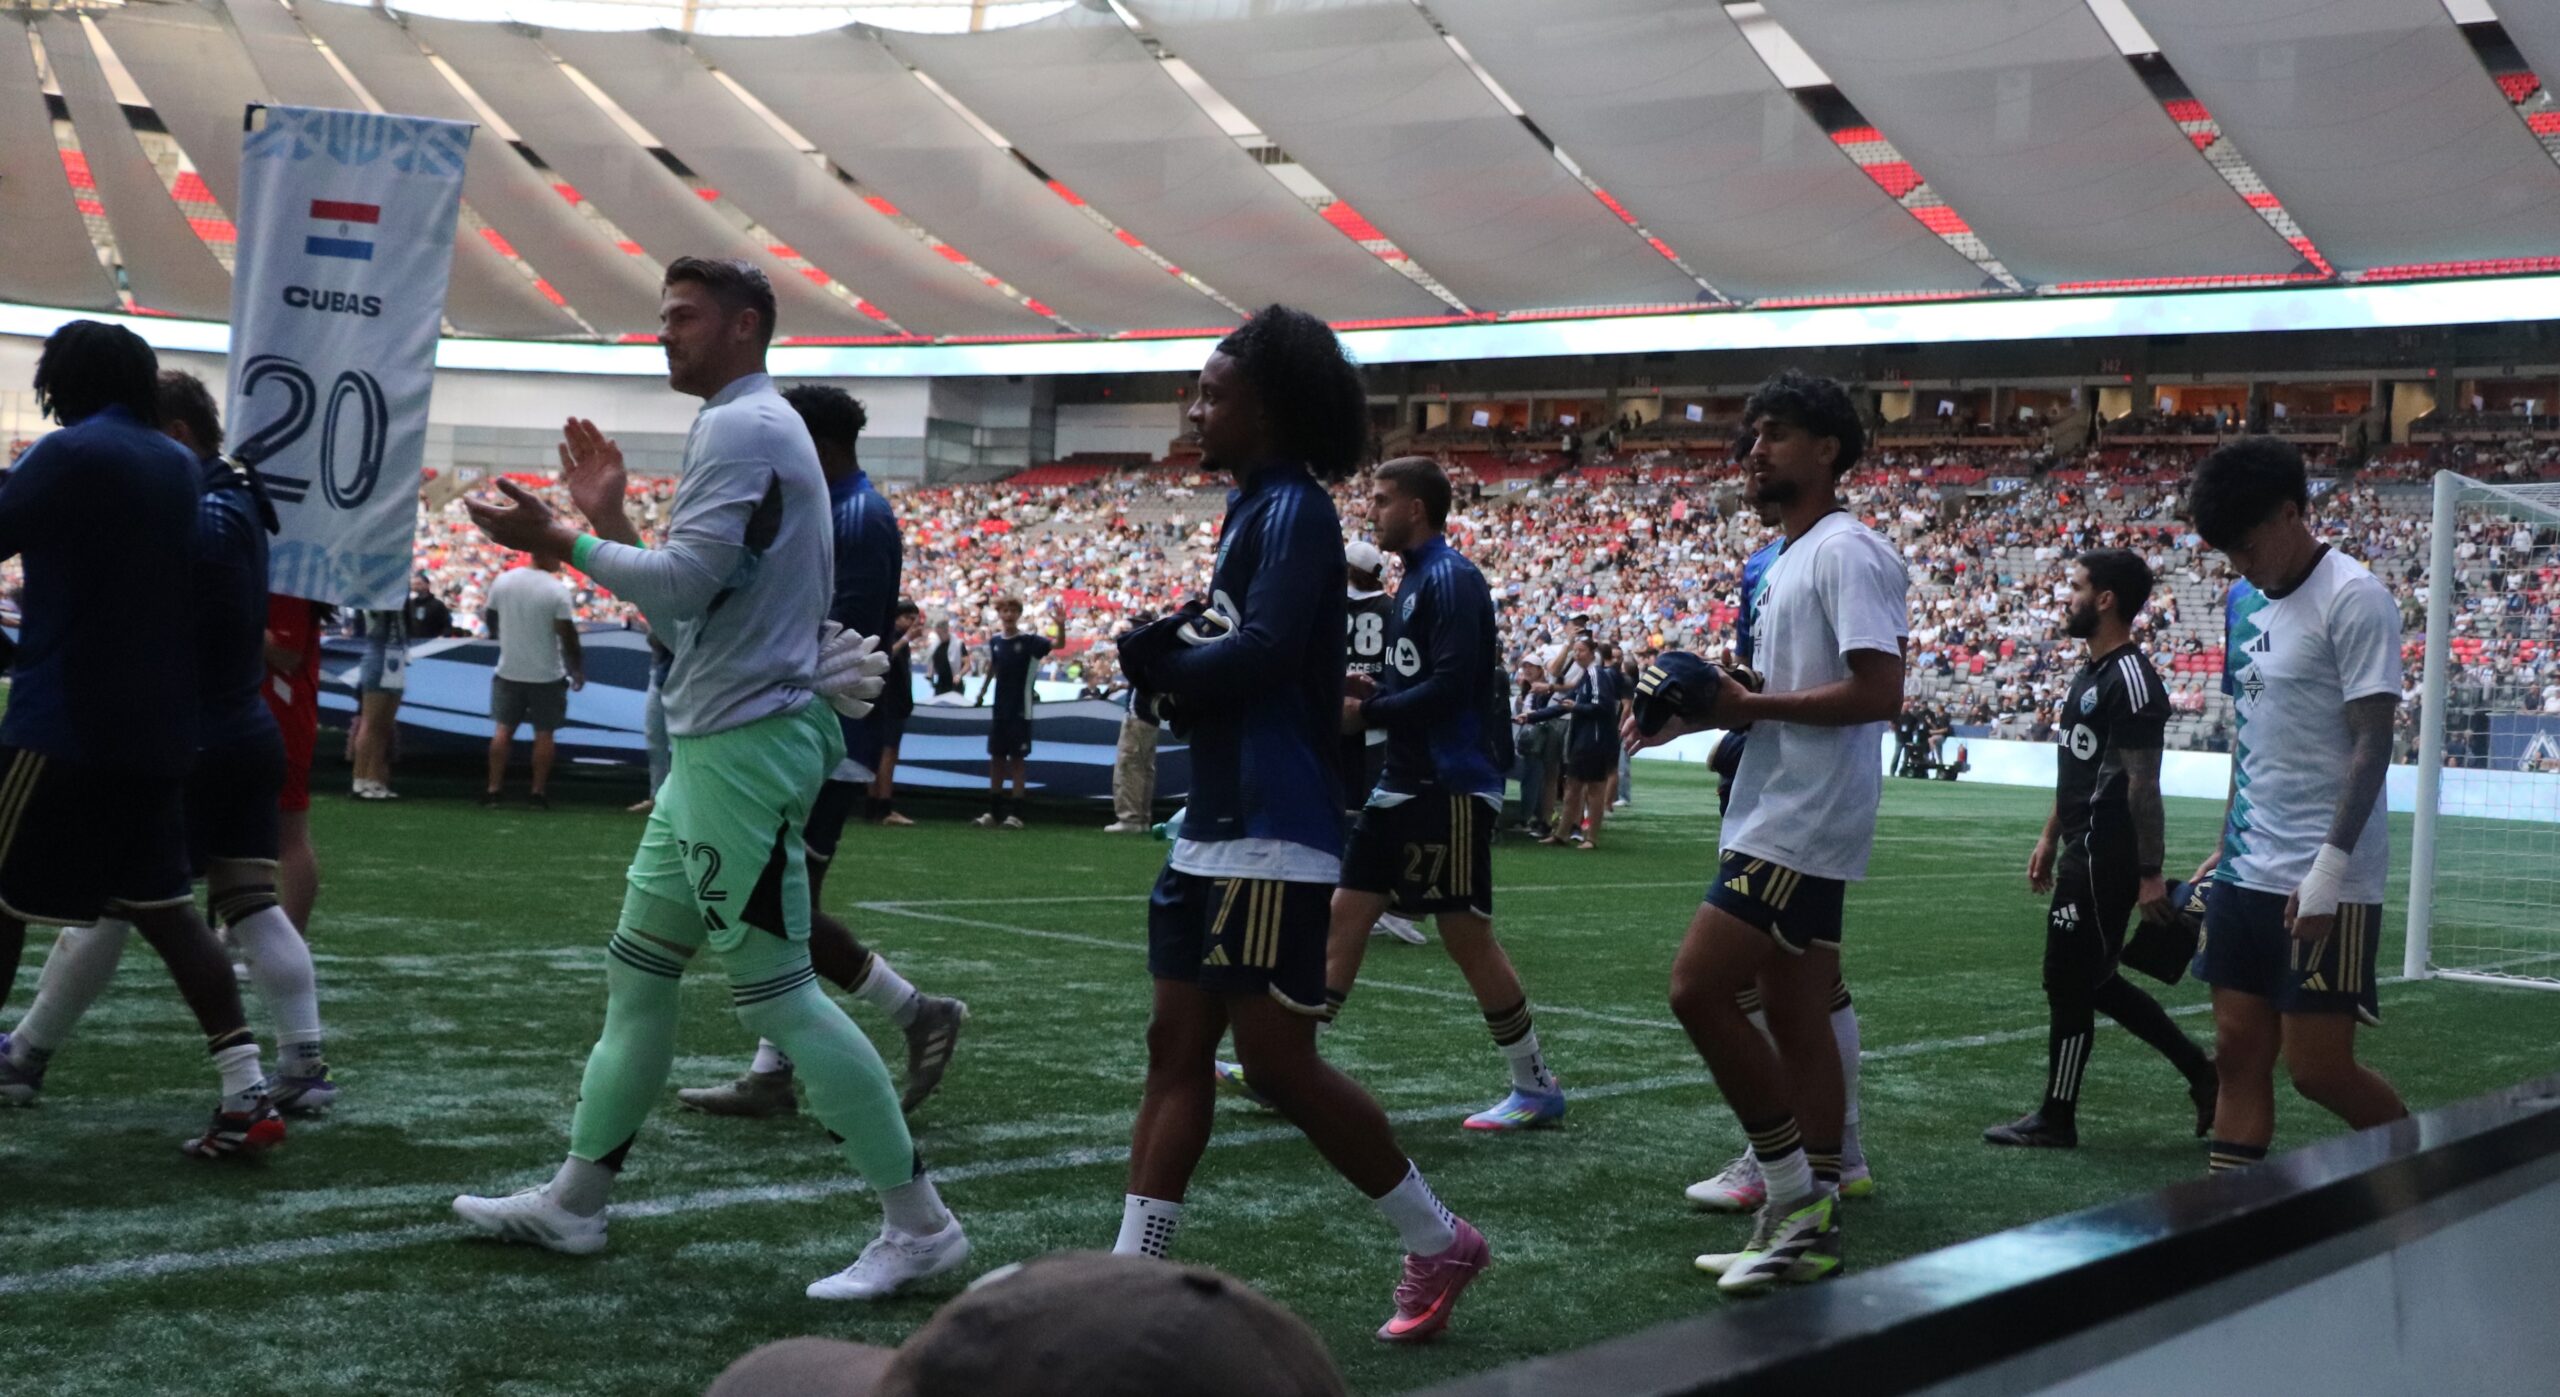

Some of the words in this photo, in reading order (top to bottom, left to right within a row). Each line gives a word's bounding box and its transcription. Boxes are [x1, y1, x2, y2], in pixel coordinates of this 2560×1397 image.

[283, 285, 382, 317] CUBAS
[236, 354, 388, 511] 20
[1346, 662, 1383, 674] CCESS
[1403, 842, 1448, 885] 27
